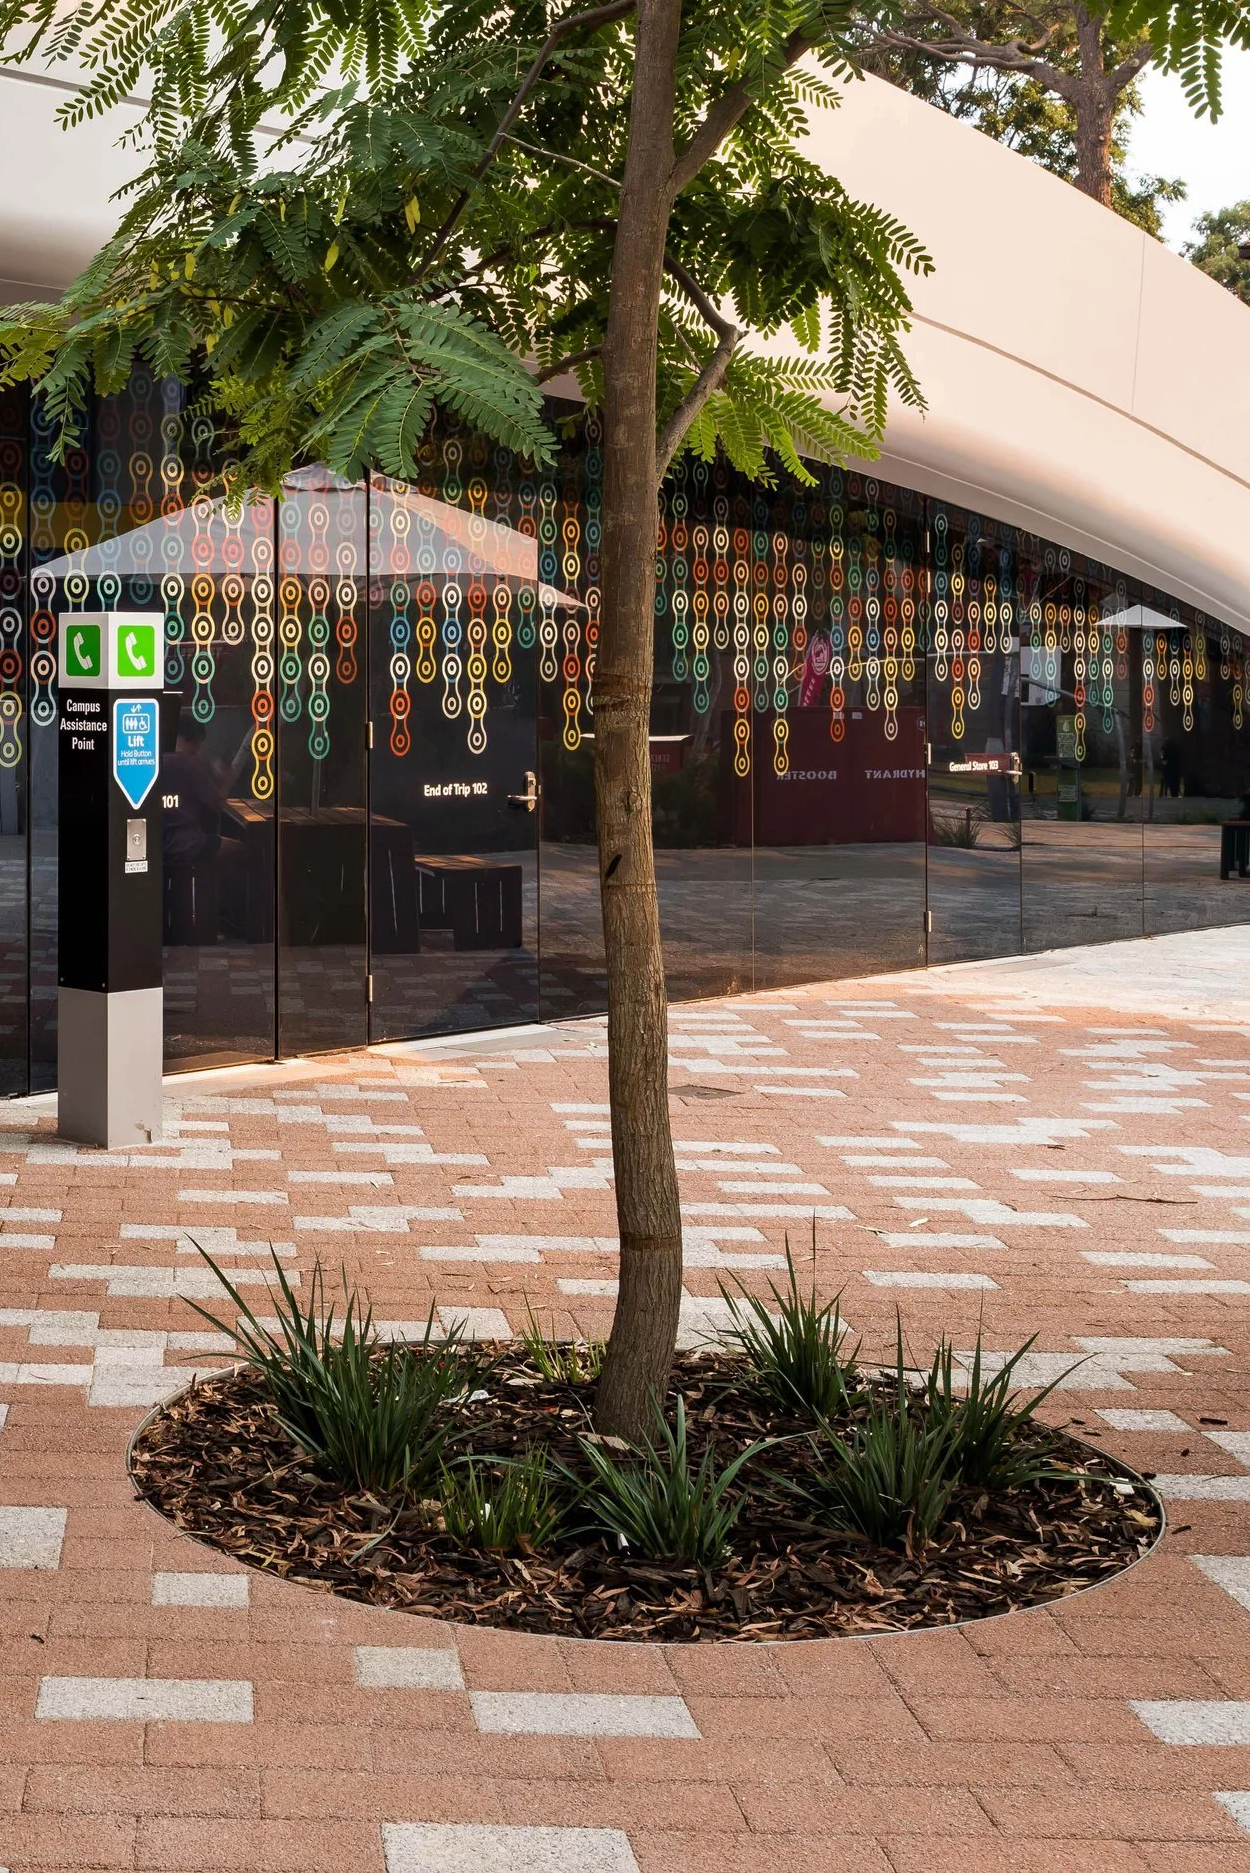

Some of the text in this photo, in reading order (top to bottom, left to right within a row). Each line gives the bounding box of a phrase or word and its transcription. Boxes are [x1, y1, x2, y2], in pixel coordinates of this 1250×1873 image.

[66, 698, 101, 716] Campus
[59, 717, 108, 732] Assistance
[71, 736, 95, 751] Point
[127, 735, 145, 748] Lift
[134, 749, 152, 757] Button
[118, 758, 129, 766] until
[949, 760, 999, 772] General Store 103
[423, 782, 488, 798] End of Trip 102
[161, 794, 179, 809] 101
